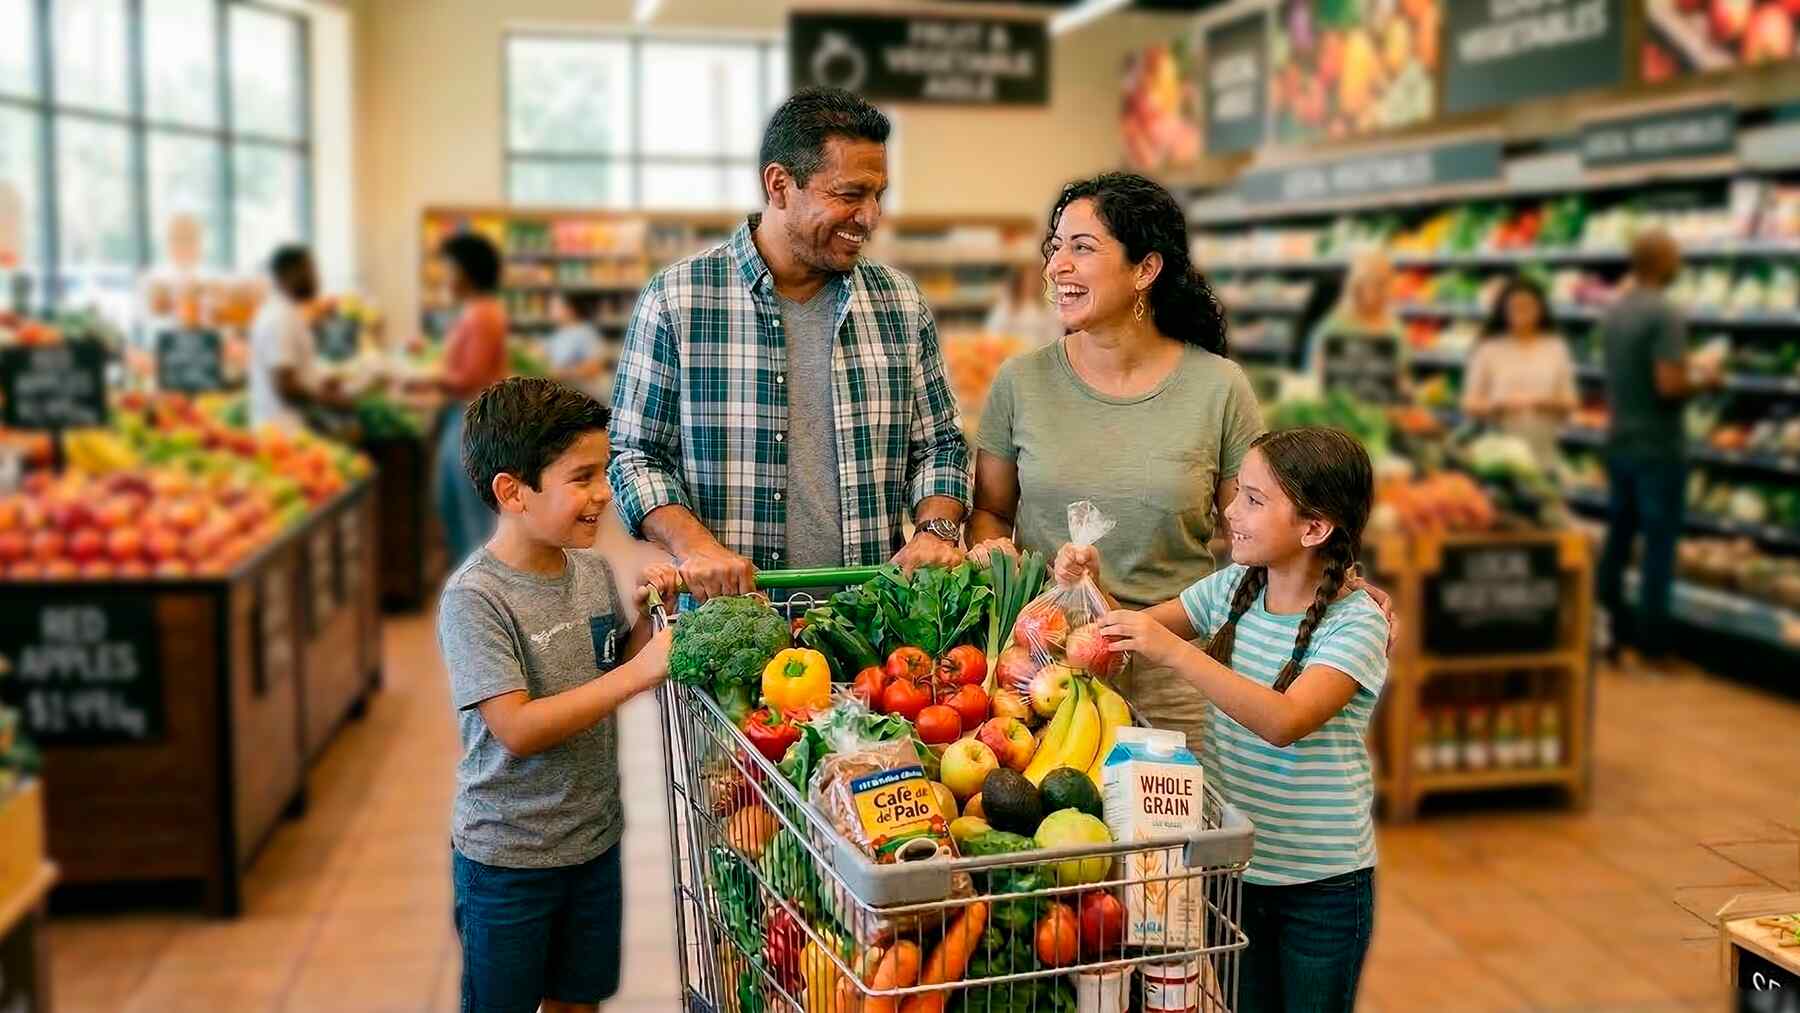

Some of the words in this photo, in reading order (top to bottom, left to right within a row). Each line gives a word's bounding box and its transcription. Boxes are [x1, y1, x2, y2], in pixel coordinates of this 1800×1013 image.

[41, 604, 107, 641] RED
[20, 642, 139, 681] APPLES
[1140, 775, 1193, 797] WHOLE
[894, 800, 929, 821] Palo
[1143, 796, 1190, 816] GRAIN
